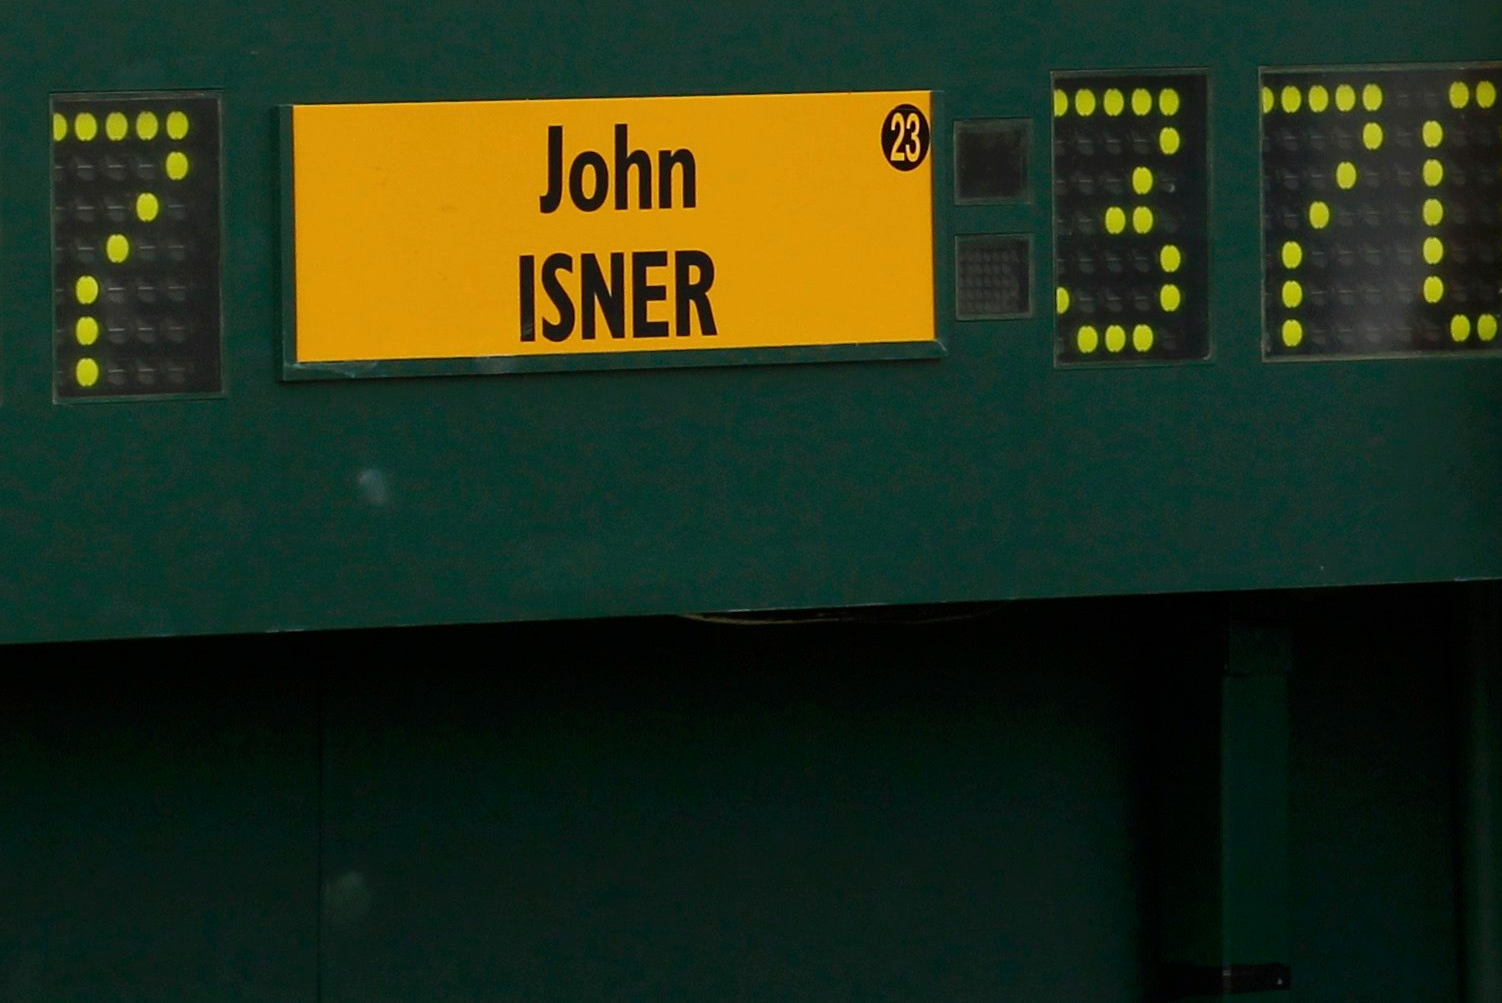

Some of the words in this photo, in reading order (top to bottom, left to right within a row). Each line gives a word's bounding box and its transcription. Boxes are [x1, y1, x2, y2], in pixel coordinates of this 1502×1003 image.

[539, 123, 696, 214] John
[890, 112, 921, 163] 23
[53, 112, 188, 386] 7
[1054, 89, 1181, 353] 3
[519, 250, 718, 343] ISNER
